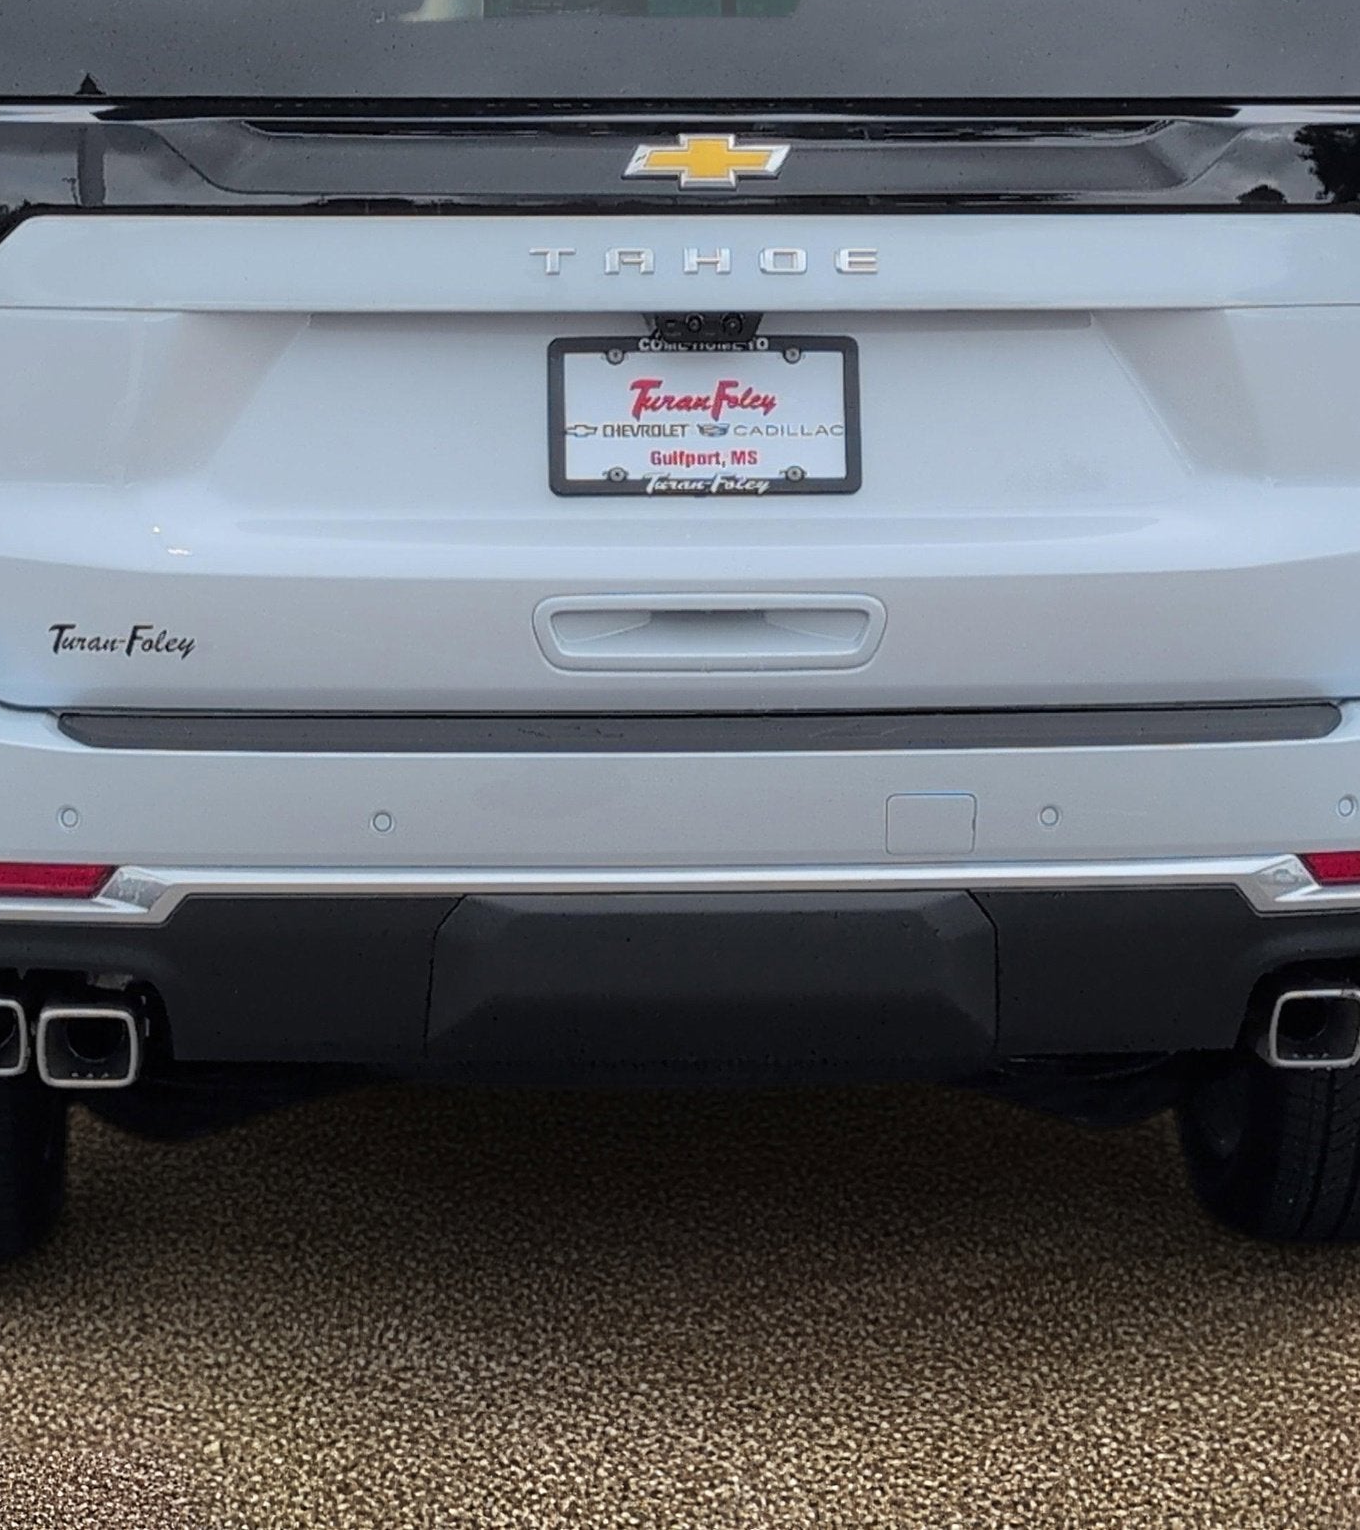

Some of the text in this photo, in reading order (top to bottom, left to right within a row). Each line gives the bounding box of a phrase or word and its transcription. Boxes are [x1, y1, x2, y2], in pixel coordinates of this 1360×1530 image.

[528, 247, 880, 275] TAHOE
[602, 424, 844, 438] CHEVROLET CADILLAC
[650, 450, 758, 468] Gulfport, MS
